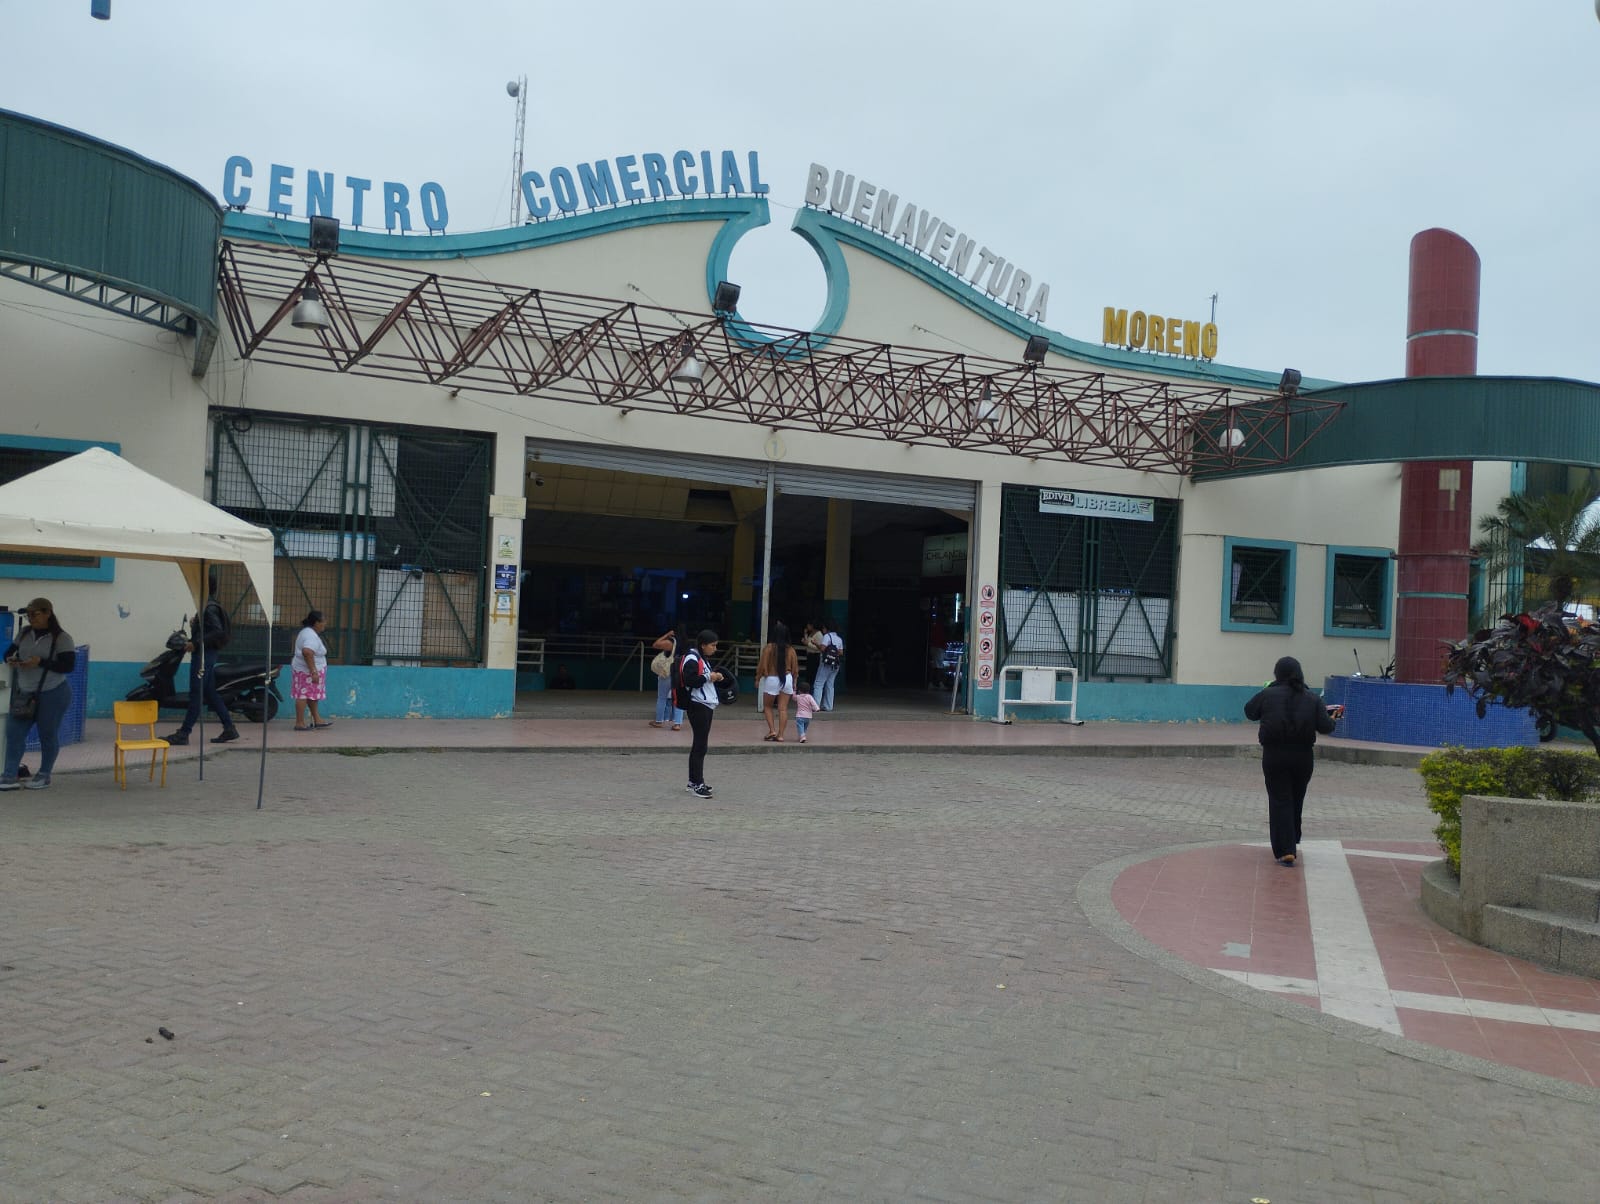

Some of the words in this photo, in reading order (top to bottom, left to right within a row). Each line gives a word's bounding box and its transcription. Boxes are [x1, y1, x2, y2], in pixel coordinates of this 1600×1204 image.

[223, 155, 449, 231] CENTRO
[521, 150, 770, 218] COMERCIAL
[804, 162, 1051, 323] BUENAVENTURA
[1102, 306, 1218, 359] MORENO
[1042, 490, 1074, 503] EDIVEL
